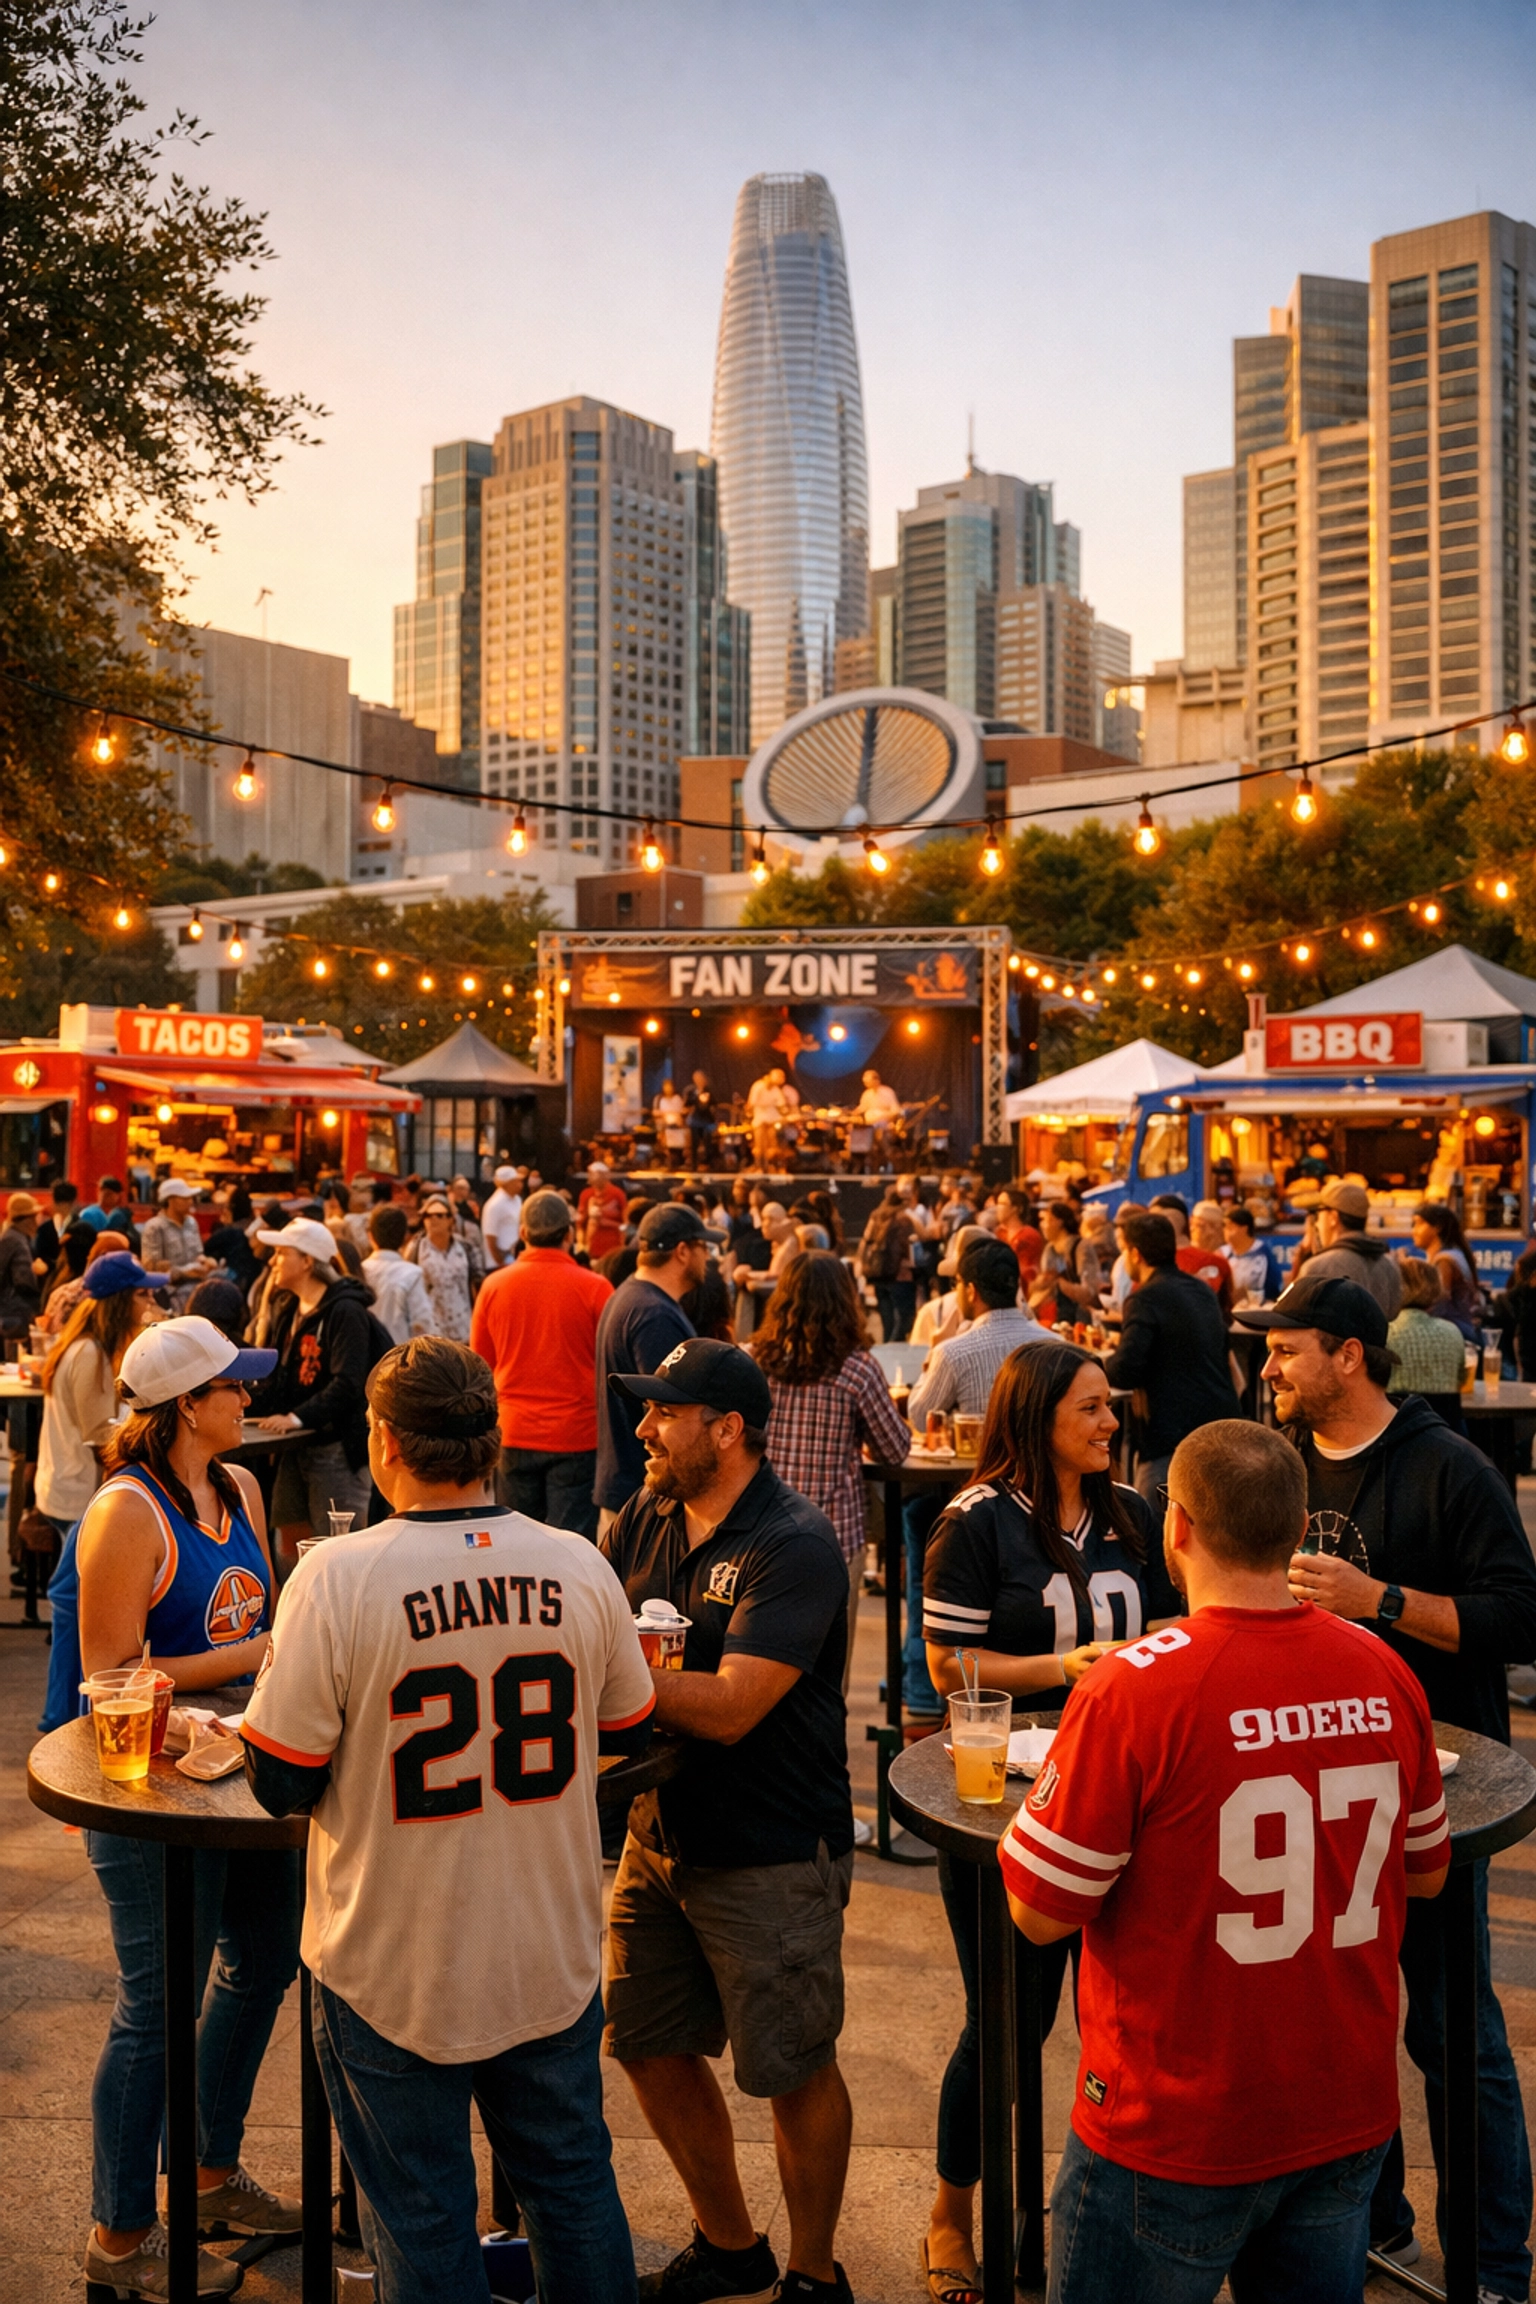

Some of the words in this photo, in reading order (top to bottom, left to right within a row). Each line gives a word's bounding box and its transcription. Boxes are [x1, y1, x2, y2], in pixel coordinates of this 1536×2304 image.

[669, 955, 753, 998] FAN
[763, 953, 878, 996] ZONE
[133, 1015, 251, 1057] TACOS
[1289, 1020, 1395, 1064] BBQ
[402, 1575, 562, 1642] GIANTS
[389, 1650, 577, 1825] 28
[1215, 1760, 1401, 1965] 97
